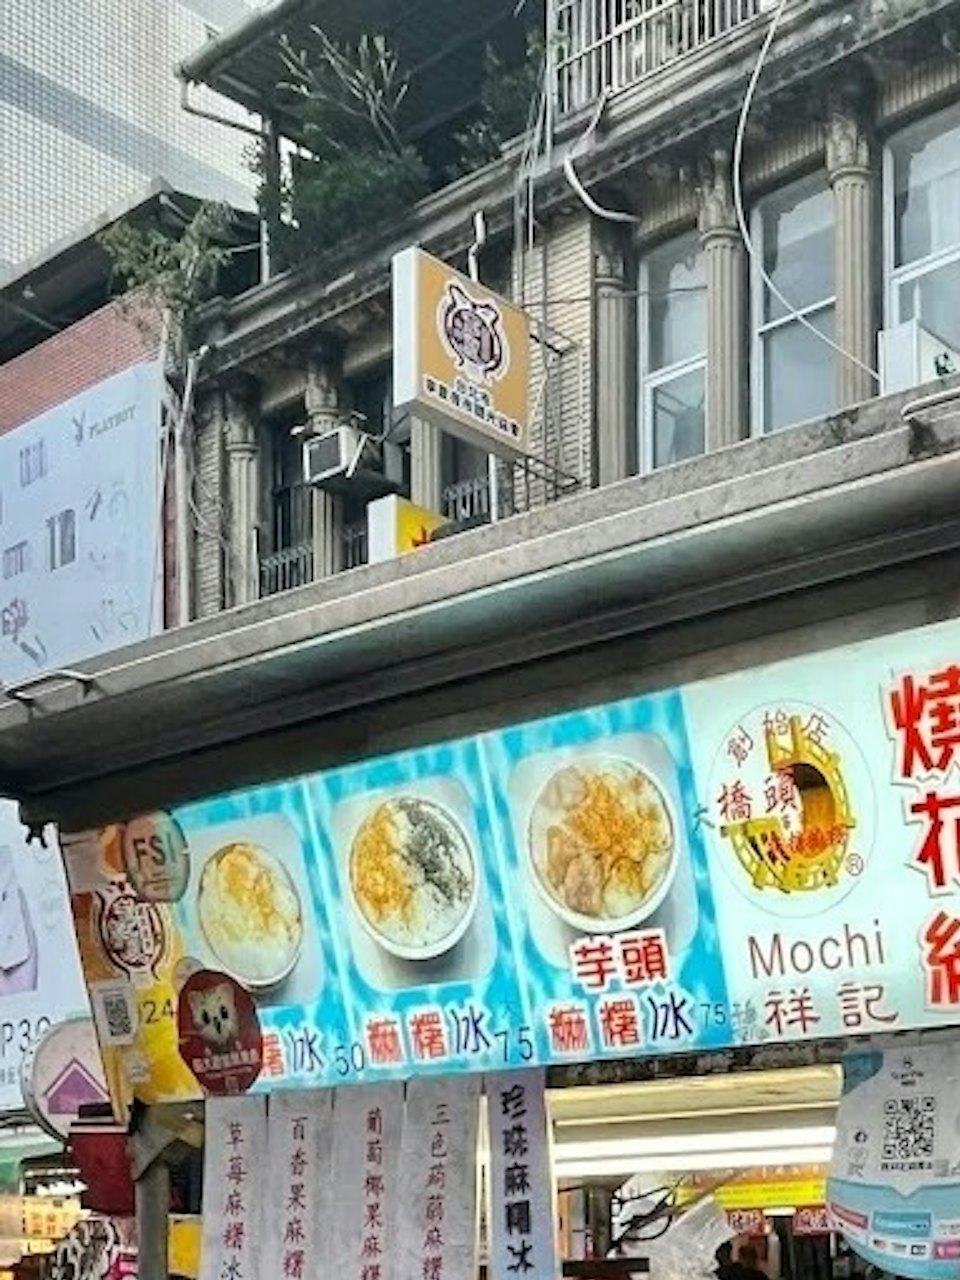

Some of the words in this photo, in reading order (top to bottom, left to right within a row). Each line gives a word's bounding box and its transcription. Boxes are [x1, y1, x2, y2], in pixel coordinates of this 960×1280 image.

[89, 404, 136, 440] PLAYBOY
[576, 935, 668, 986] 芋頭
[748, 919, 885, 979] Mochi
[701, 1003, 727, 1027] 75
[765, 984, 900, 1035] 祥記
[335, 1044, 365, 1077] 50
[495, 1026, 534, 1063] 75
